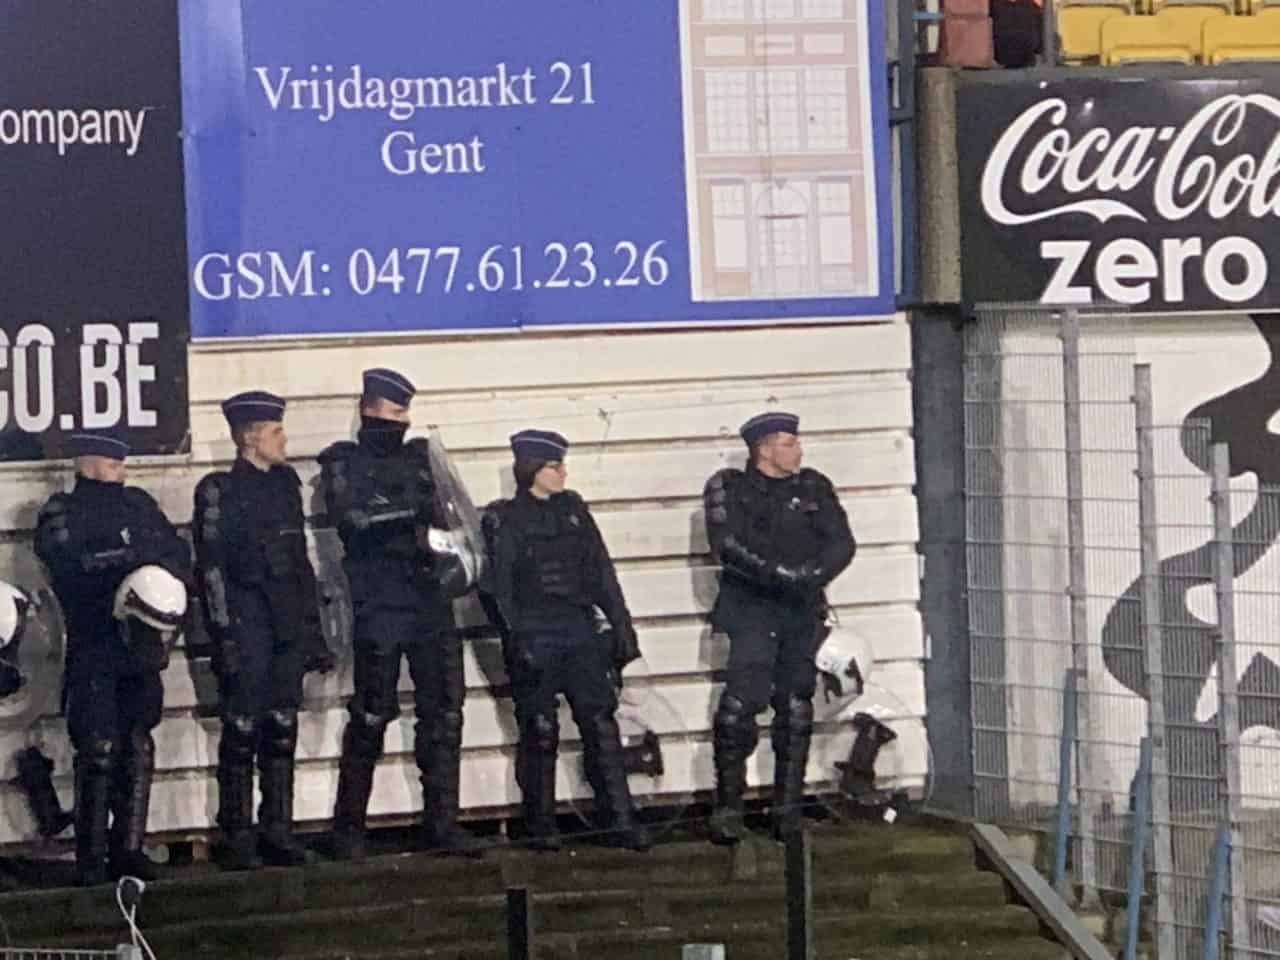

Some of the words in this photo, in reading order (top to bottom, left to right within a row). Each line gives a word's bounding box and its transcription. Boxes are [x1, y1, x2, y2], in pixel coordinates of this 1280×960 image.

[253, 63, 537, 122] Vrijdagmarkt
[549, 61, 597, 106] 21
[380, 130, 486, 176] Gent
[981, 93, 1280, 225] Coca-Col
[192, 252, 332, 301] GSM:
[348, 240, 670, 296] 0477.61.23.26
[1039, 236, 1268, 304] zero
